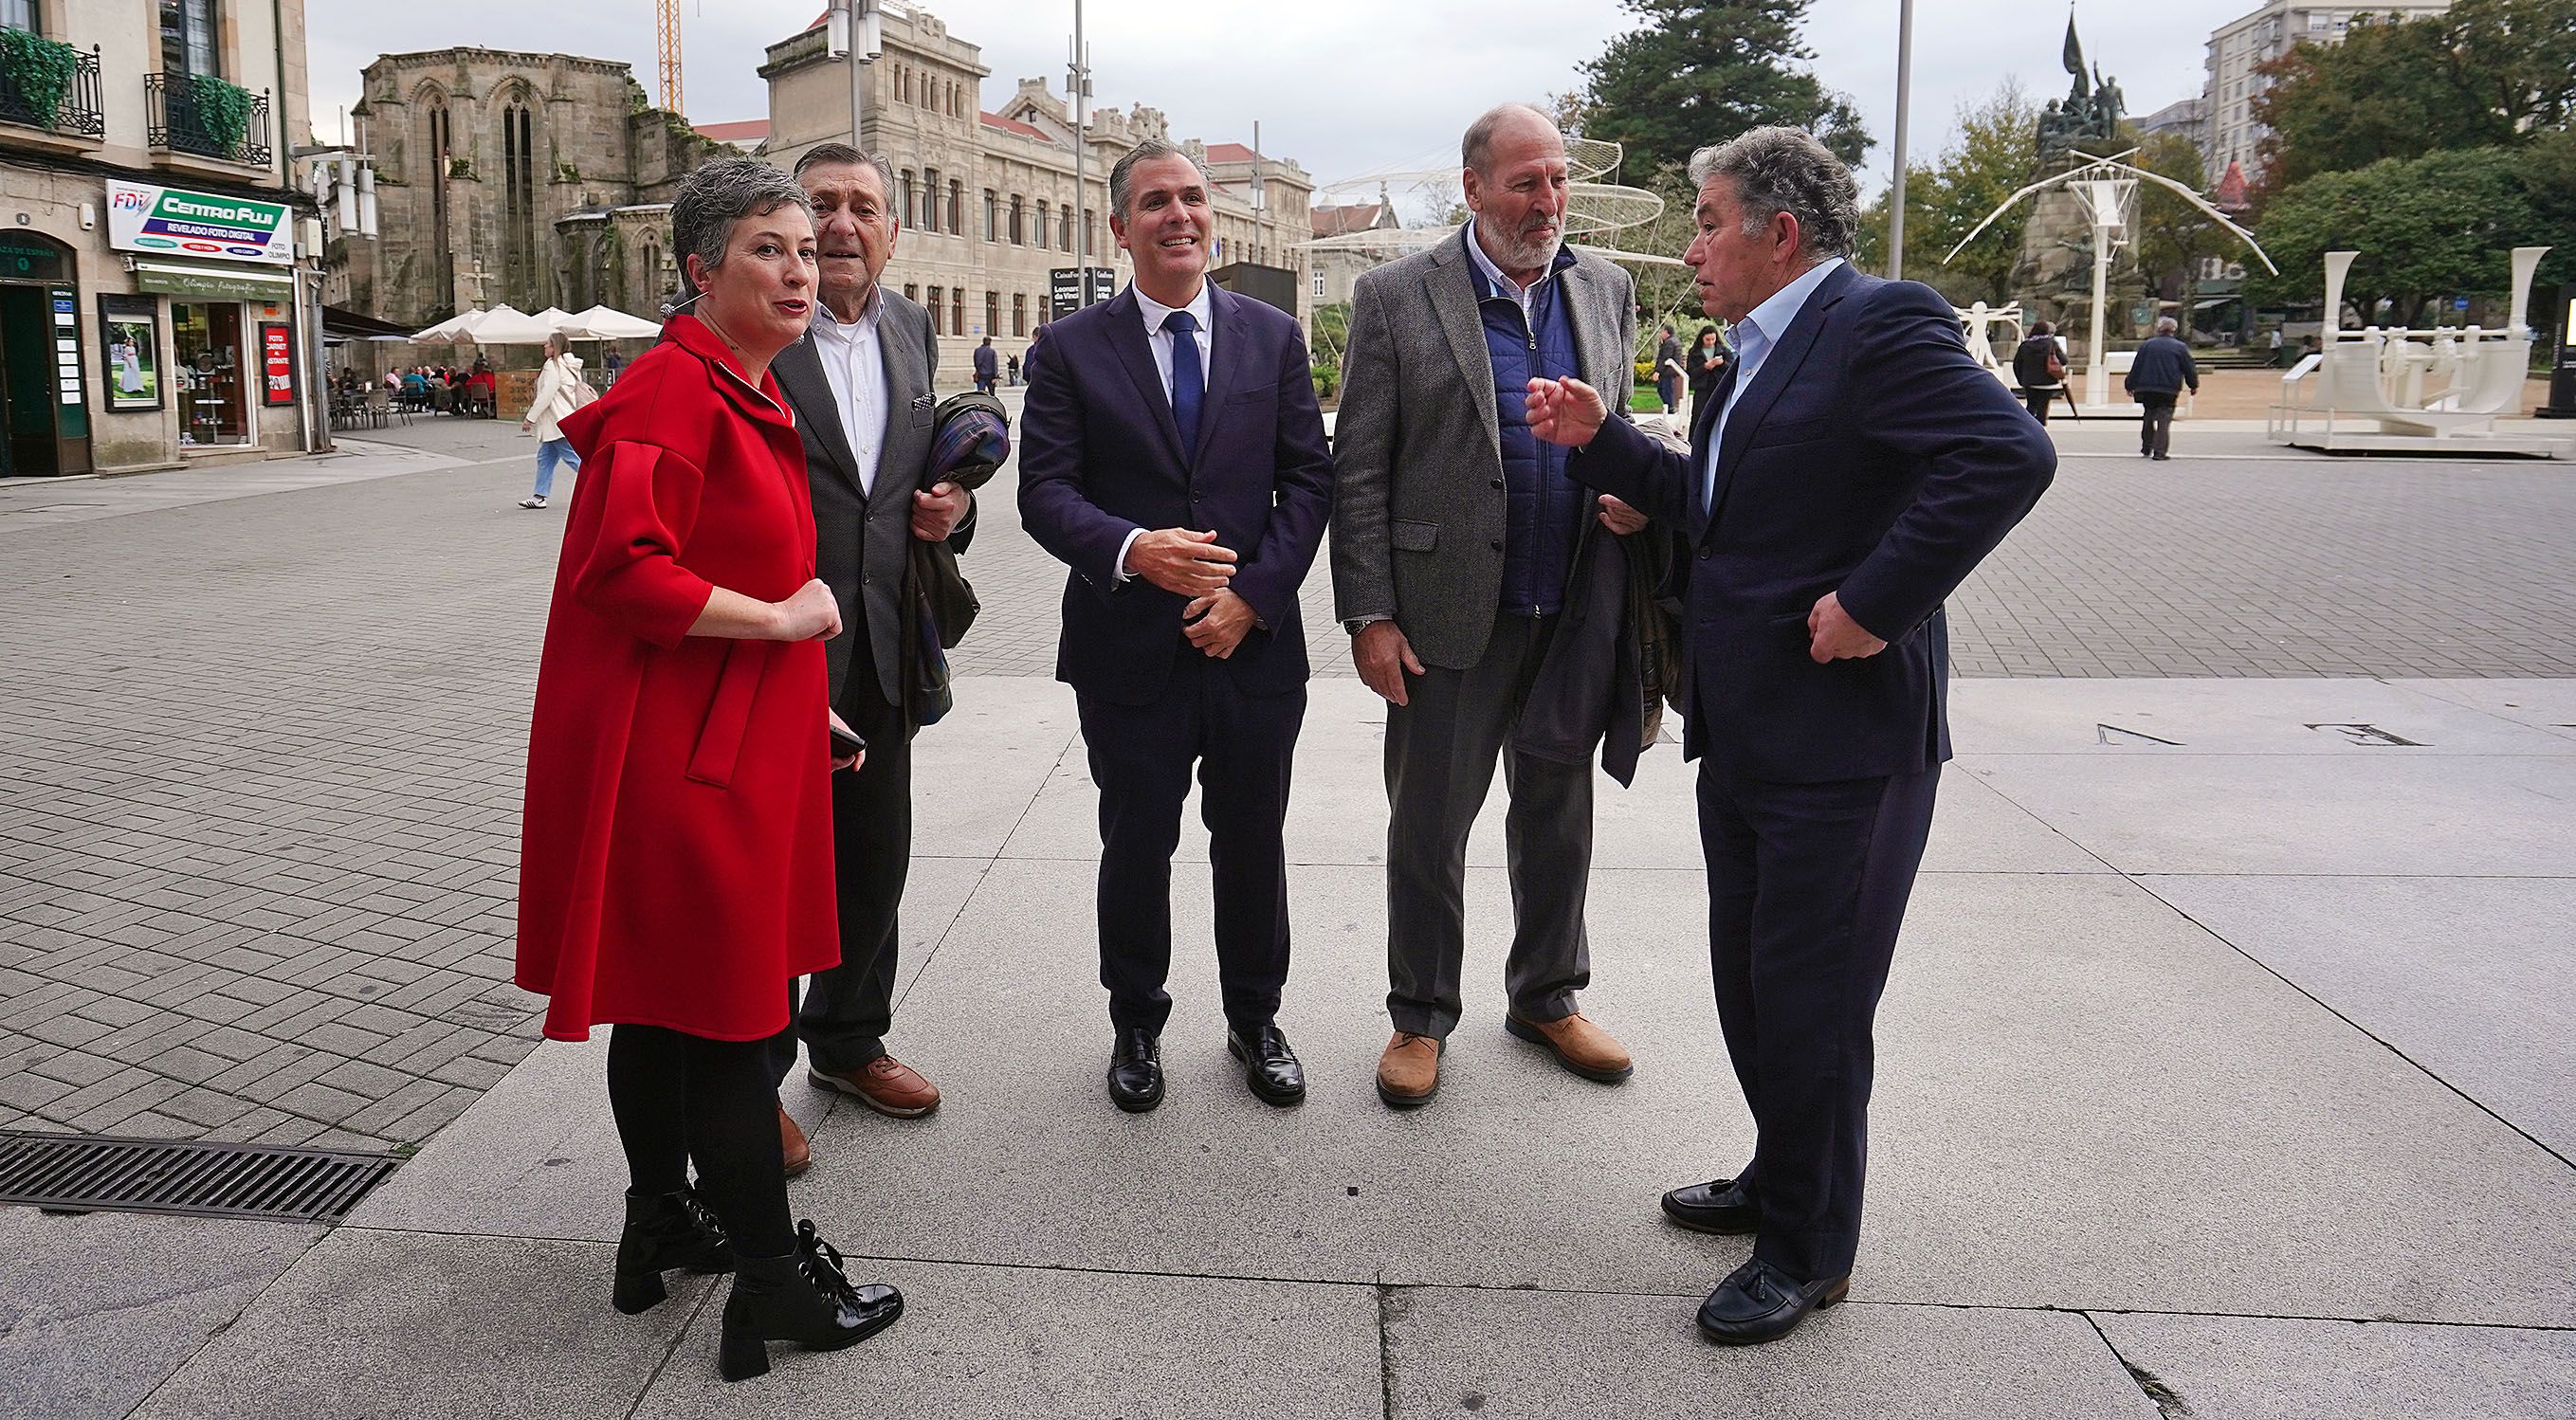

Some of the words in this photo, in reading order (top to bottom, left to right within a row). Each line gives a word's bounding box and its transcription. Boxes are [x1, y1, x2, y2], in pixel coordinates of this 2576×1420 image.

[162, 197, 236, 220] CENTRO
[167, 223, 207, 236] REVELADO
[208, 228, 228, 238] FOTO
[228, 229, 256, 241] DIGITAL
[271, 242, 286, 250] FOTO
